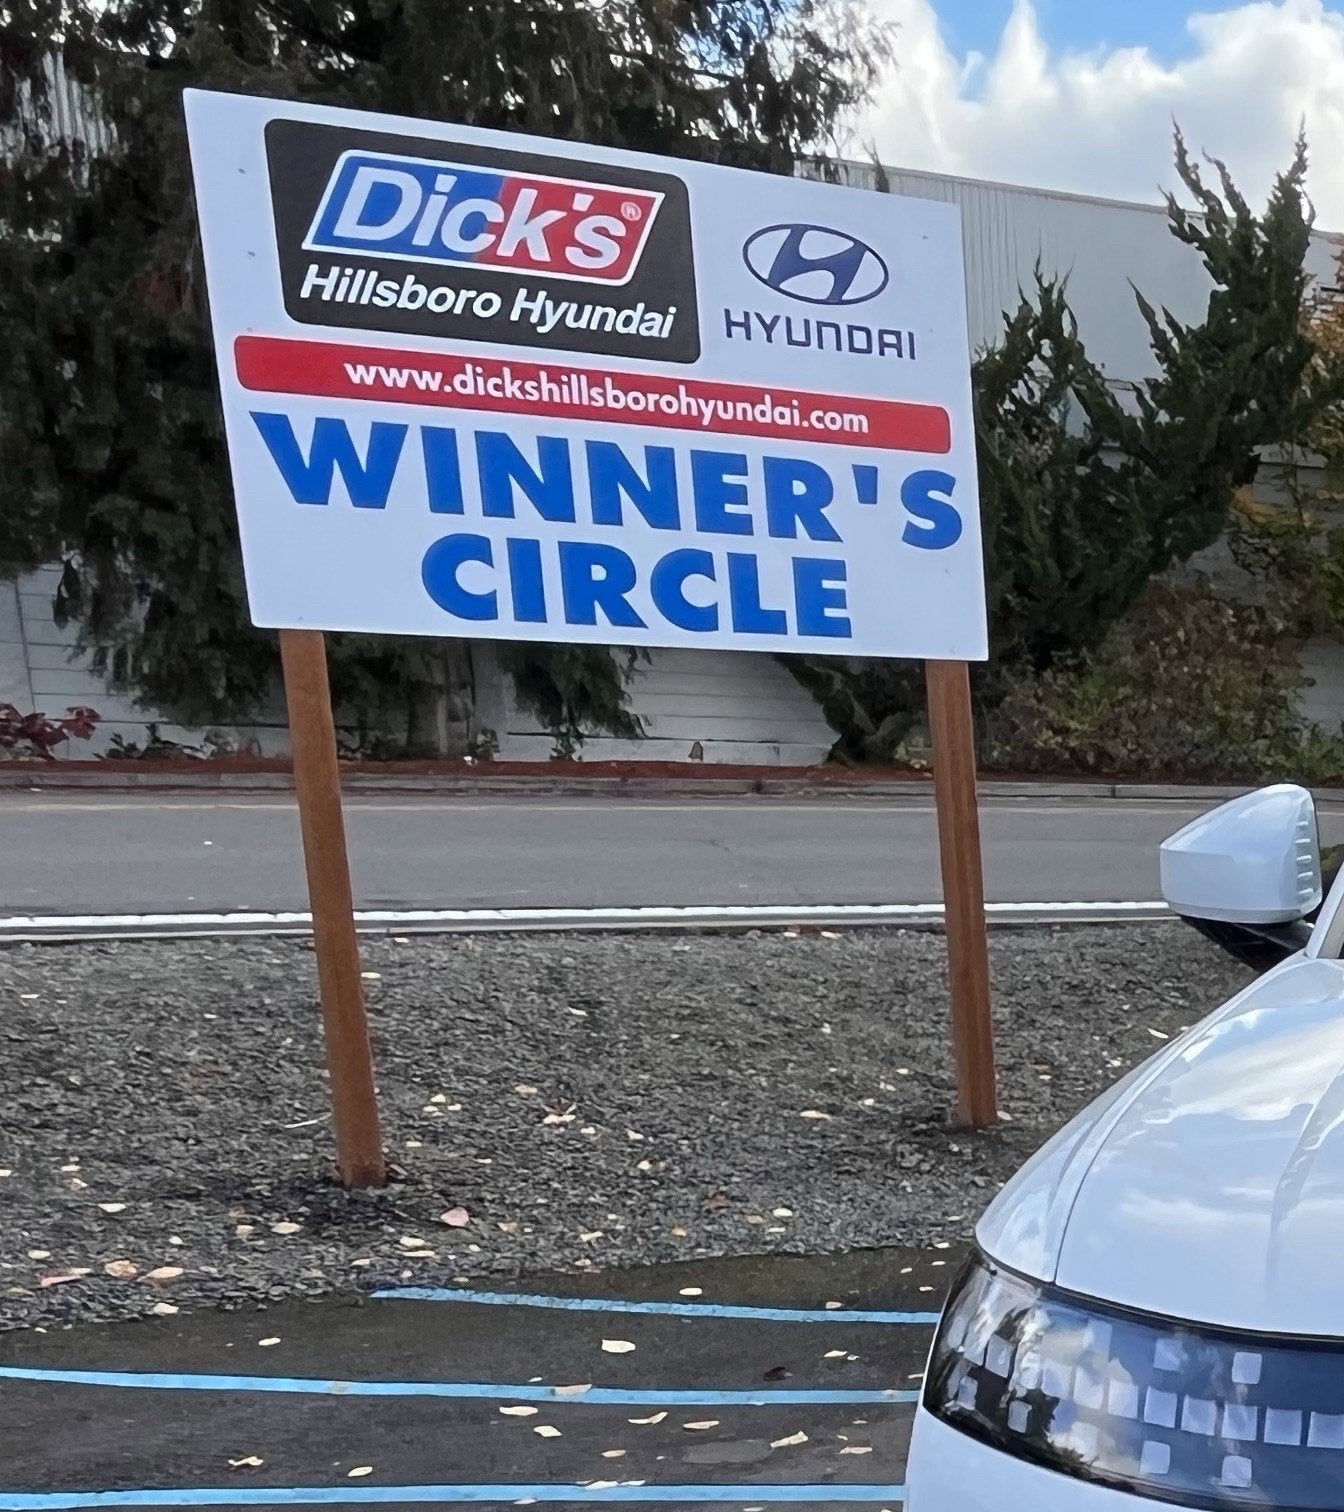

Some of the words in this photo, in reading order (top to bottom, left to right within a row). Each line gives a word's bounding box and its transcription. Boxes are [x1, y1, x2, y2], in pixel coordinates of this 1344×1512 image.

[333, 166, 627, 269] Dick's
[299, 264, 503, 319] Hillsboro
[509, 287, 677, 340] Hyundai
[725, 307, 917, 361] HYUNDAI
[344, 358, 870, 435] www.dickshillsborohyundai.com
[248, 410, 964, 551] WINNER'S
[421, 532, 854, 639] CIRCLE
